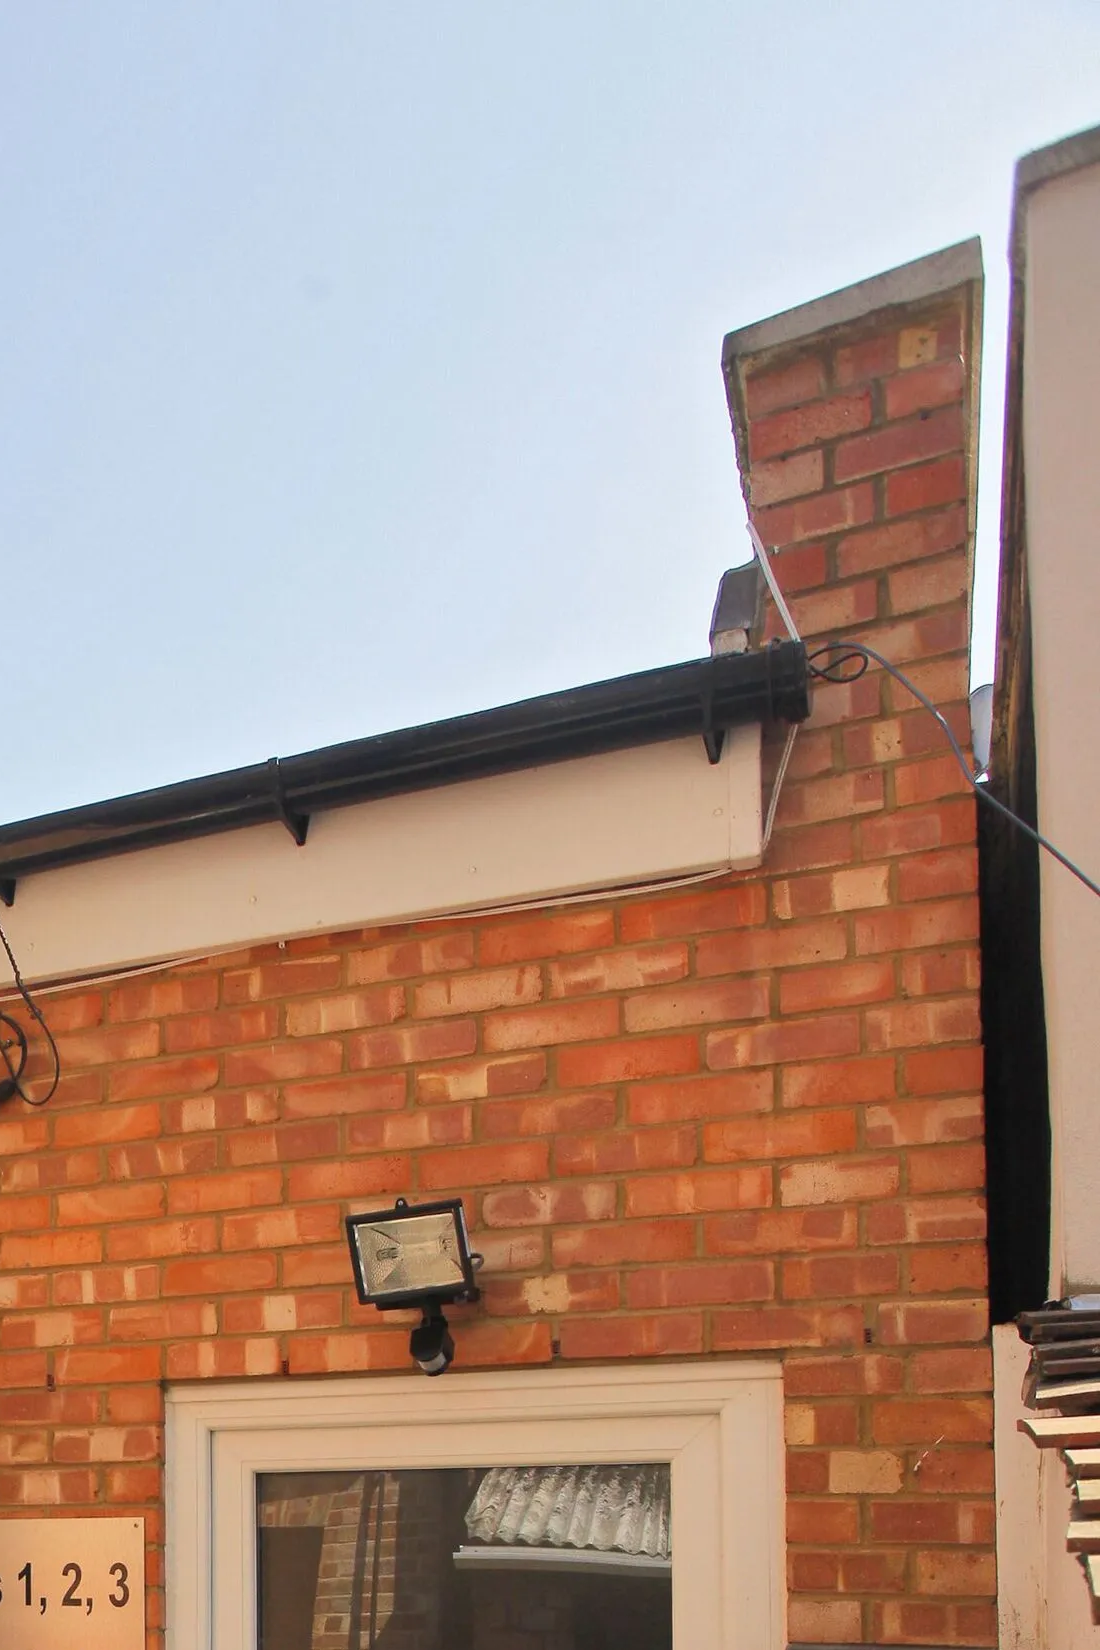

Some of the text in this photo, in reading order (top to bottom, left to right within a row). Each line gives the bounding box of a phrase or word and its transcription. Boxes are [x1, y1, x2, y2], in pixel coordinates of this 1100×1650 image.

[17, 1562, 47, 1615] 1,
[61, 1562, 93, 1616] 2,
[108, 1562, 130, 1608] 3
